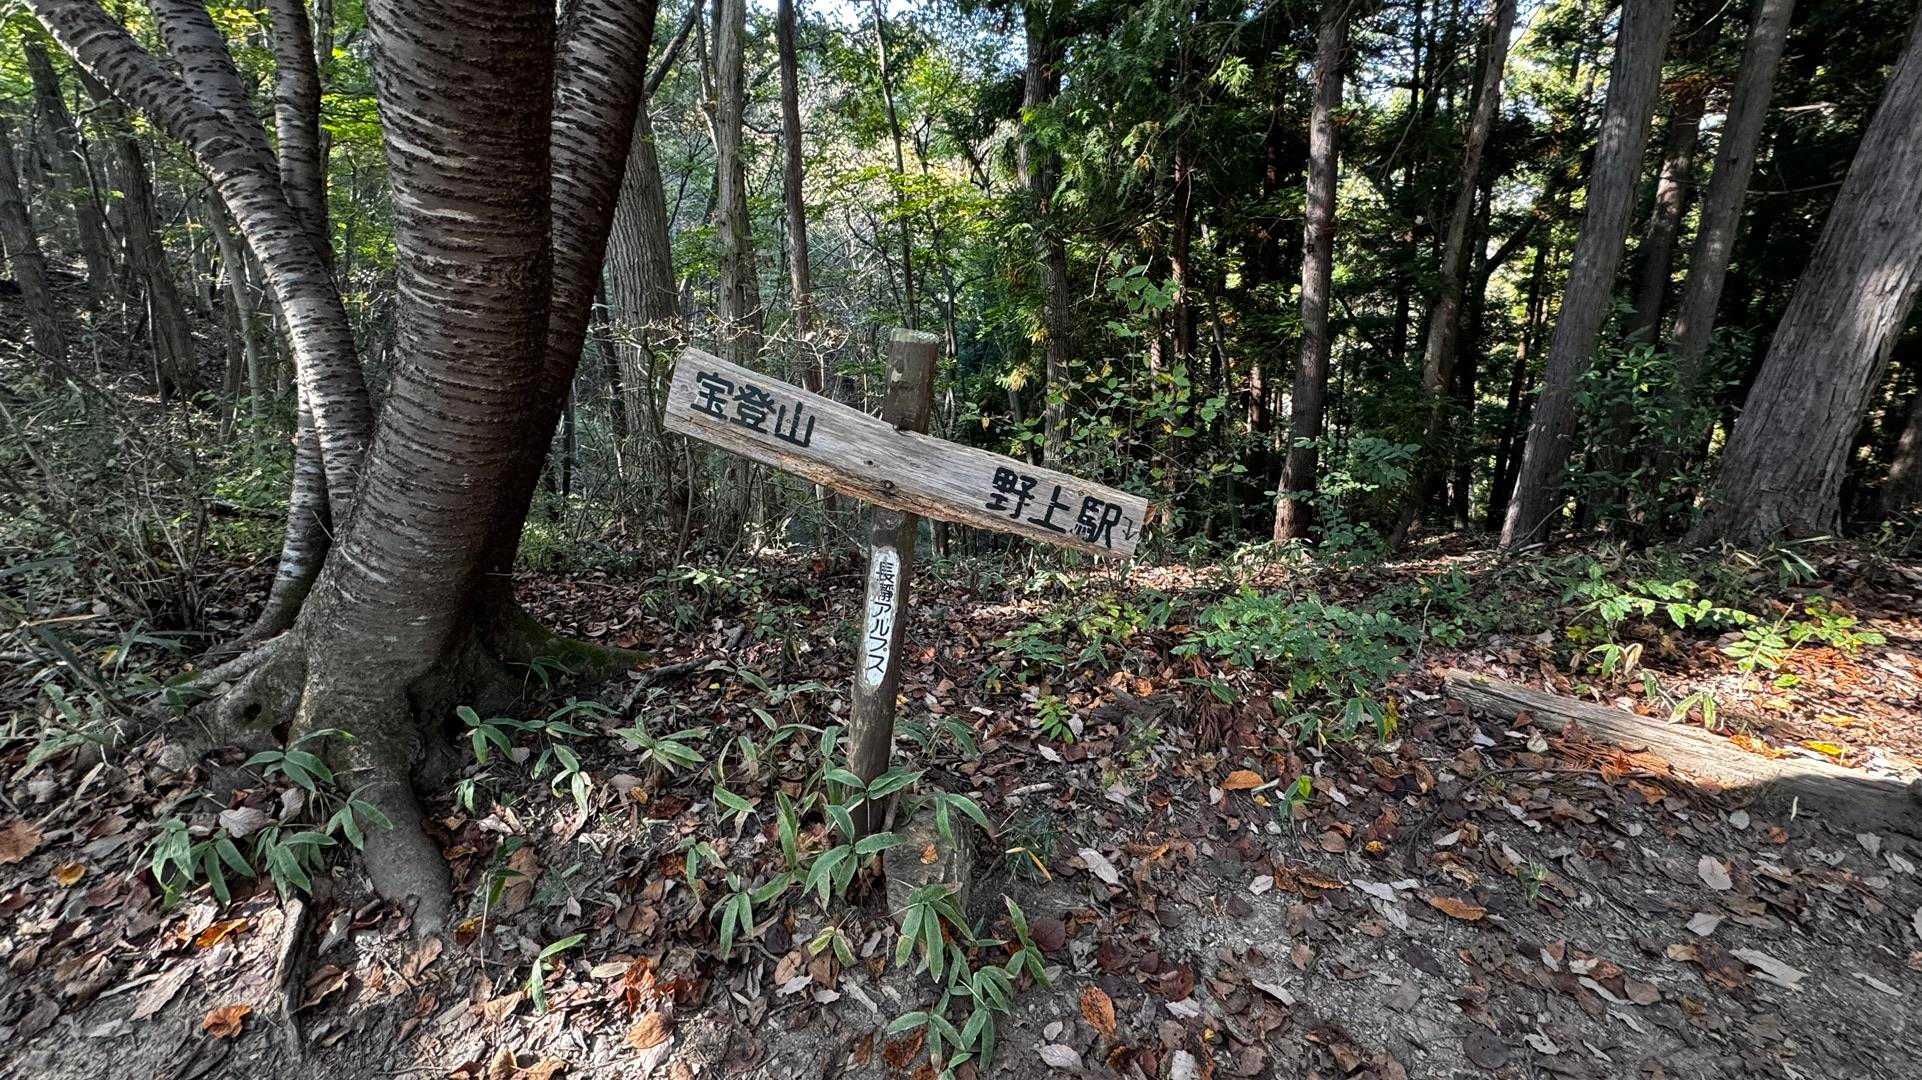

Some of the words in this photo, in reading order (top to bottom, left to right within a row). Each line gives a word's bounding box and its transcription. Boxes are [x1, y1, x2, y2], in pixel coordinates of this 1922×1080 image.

[690, 371, 816, 448] 宝登山
[985, 466, 1123, 549] 野上駅
